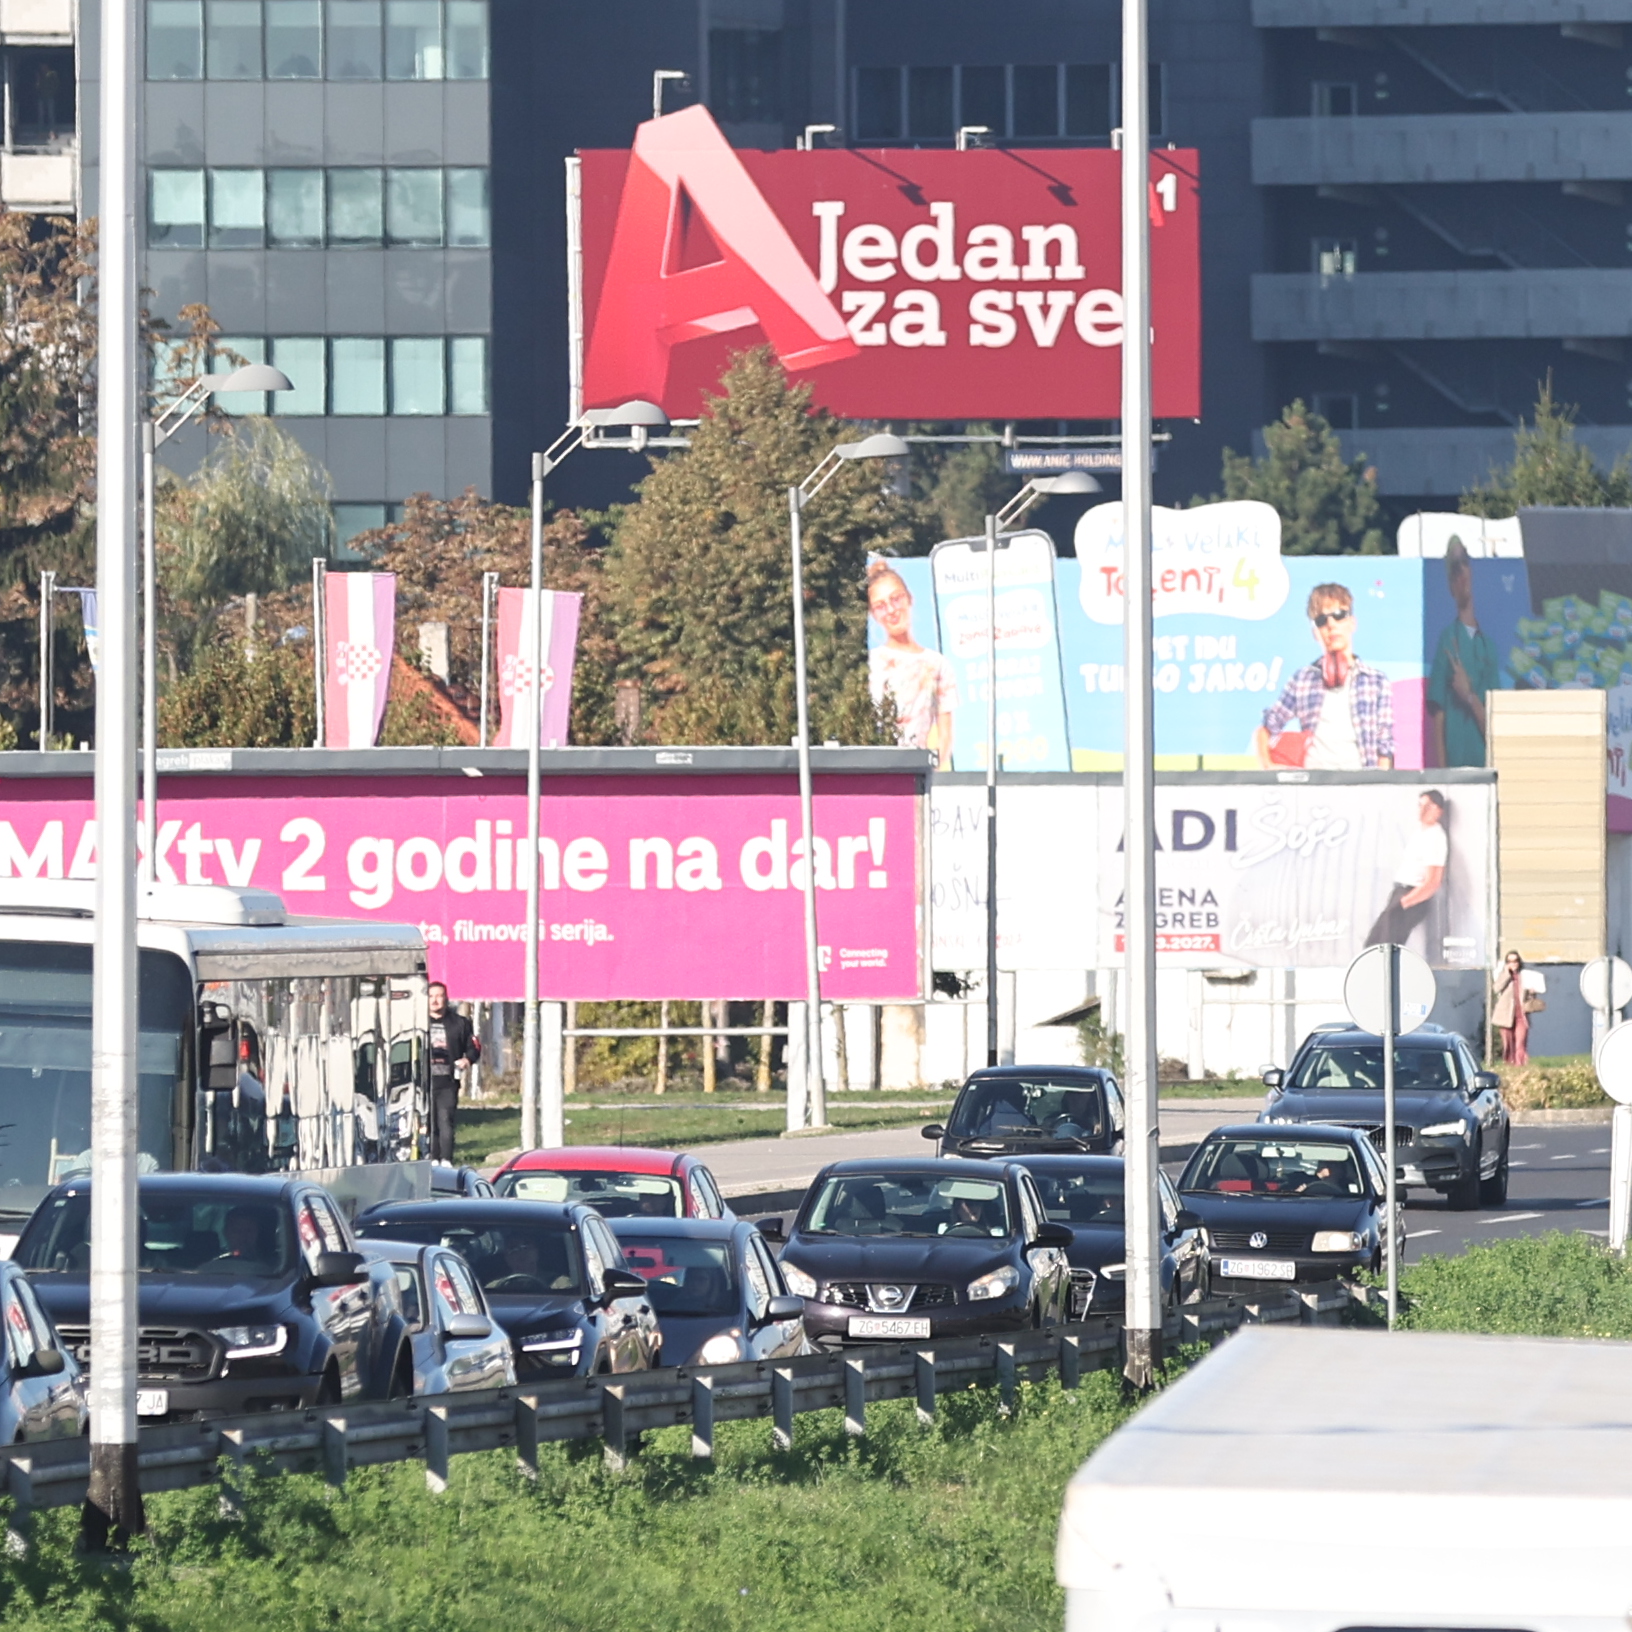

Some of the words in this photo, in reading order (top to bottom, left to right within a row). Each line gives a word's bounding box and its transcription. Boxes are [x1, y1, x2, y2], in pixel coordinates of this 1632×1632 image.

[812, 200, 1086, 294] Jedan
[841, 288, 946, 348] za
[1194, 634, 1237, 660] IDU
[1079, 662, 1182, 694] TUO
[1187, 655, 1284, 694] JAKO!
[279, 816, 327, 892] 2
[346, 817, 609, 909] godine
[629, 835, 723, 892] na
[739, 816, 888, 893] dar!
[550, 919, 615, 946] serija.
[1115, 911, 1220, 929] ZGREB
[839, 947, 888, 959] Connecting
[1229, 1262, 1243, 1274] ZG
[859, 1321, 874, 1334] ZG
